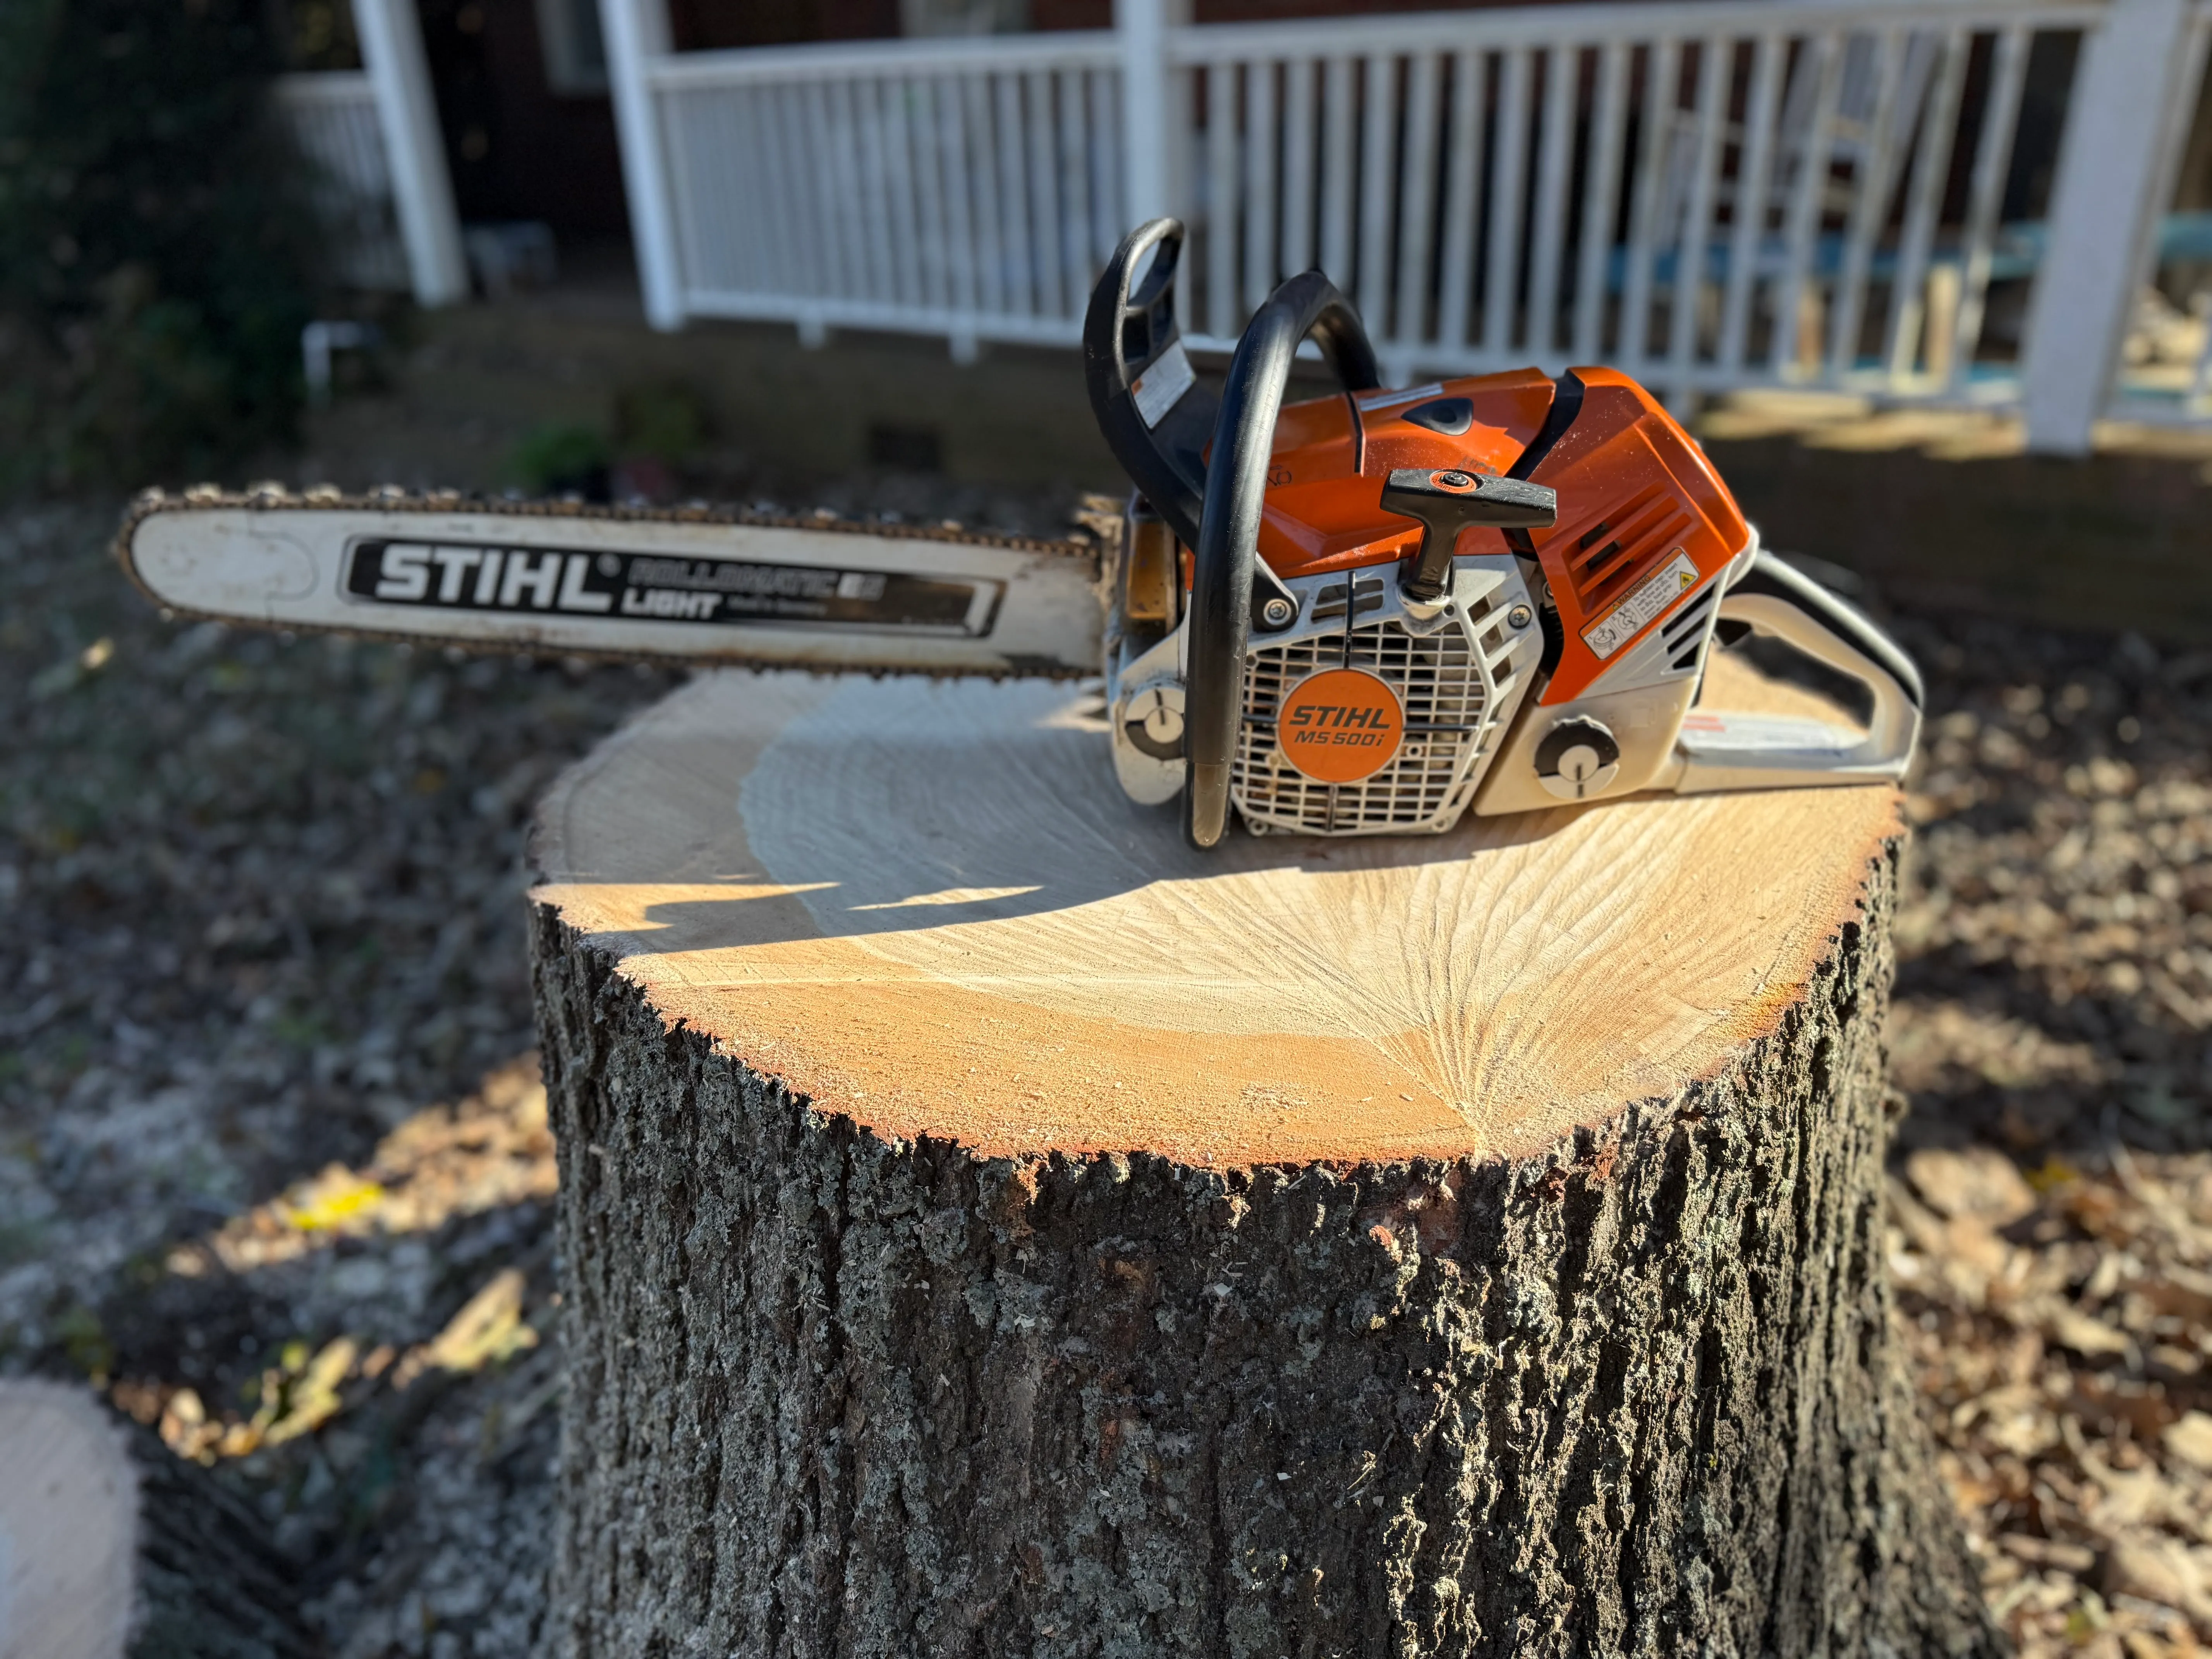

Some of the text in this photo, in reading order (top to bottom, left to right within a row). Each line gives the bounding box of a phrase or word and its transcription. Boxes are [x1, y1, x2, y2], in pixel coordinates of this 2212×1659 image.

[375, 544, 613, 612] STIHL
[1665, 563, 1678, 575] insert
[1618, 575, 1650, 604] WARNING
[621, 587, 721, 619] LIGHT
[1637, 598, 1646, 606] with
[1289, 705, 1391, 729] STIHL
[1294, 730, 1385, 747] MS 500i
